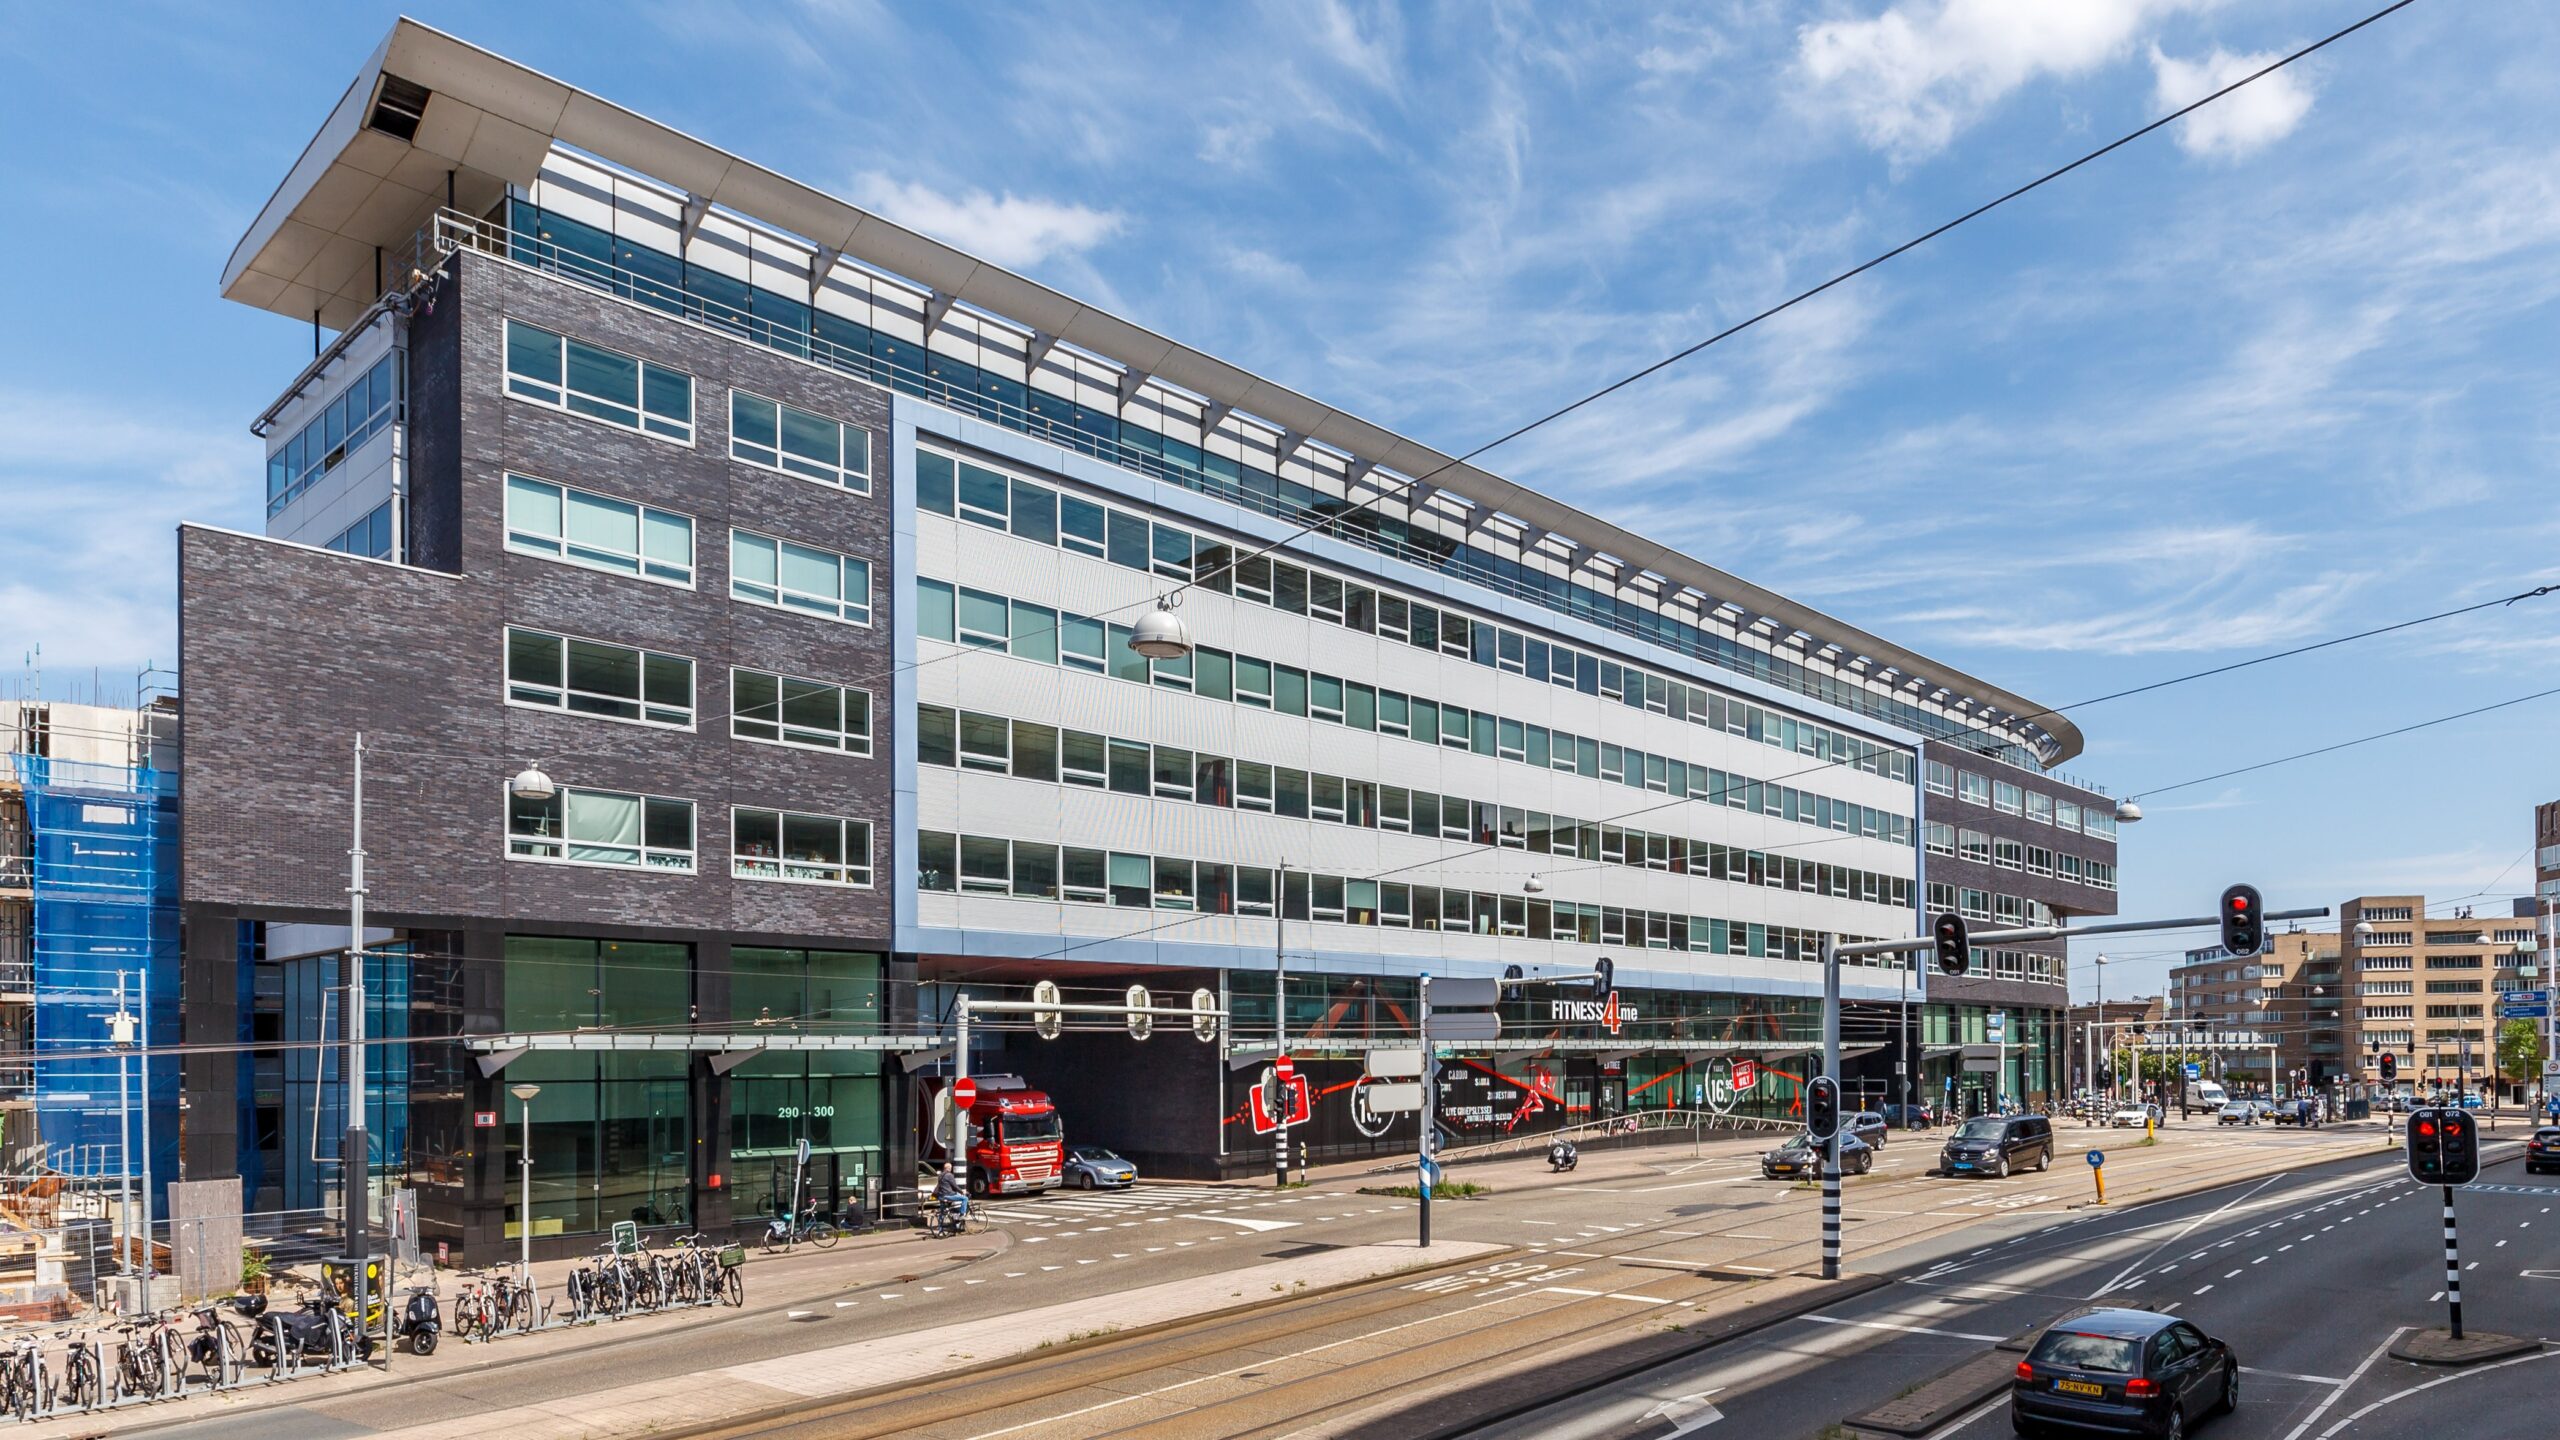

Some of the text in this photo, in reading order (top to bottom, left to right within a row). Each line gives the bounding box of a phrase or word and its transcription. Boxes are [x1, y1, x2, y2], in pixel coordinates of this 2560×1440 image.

[1448, 1070, 1468, 1080] CARDIO
[778, 1107, 799, 1118] 290
[814, 1105, 834, 1117] 300
[2060, 1381, 2099, 1394] 75-NV-KN
